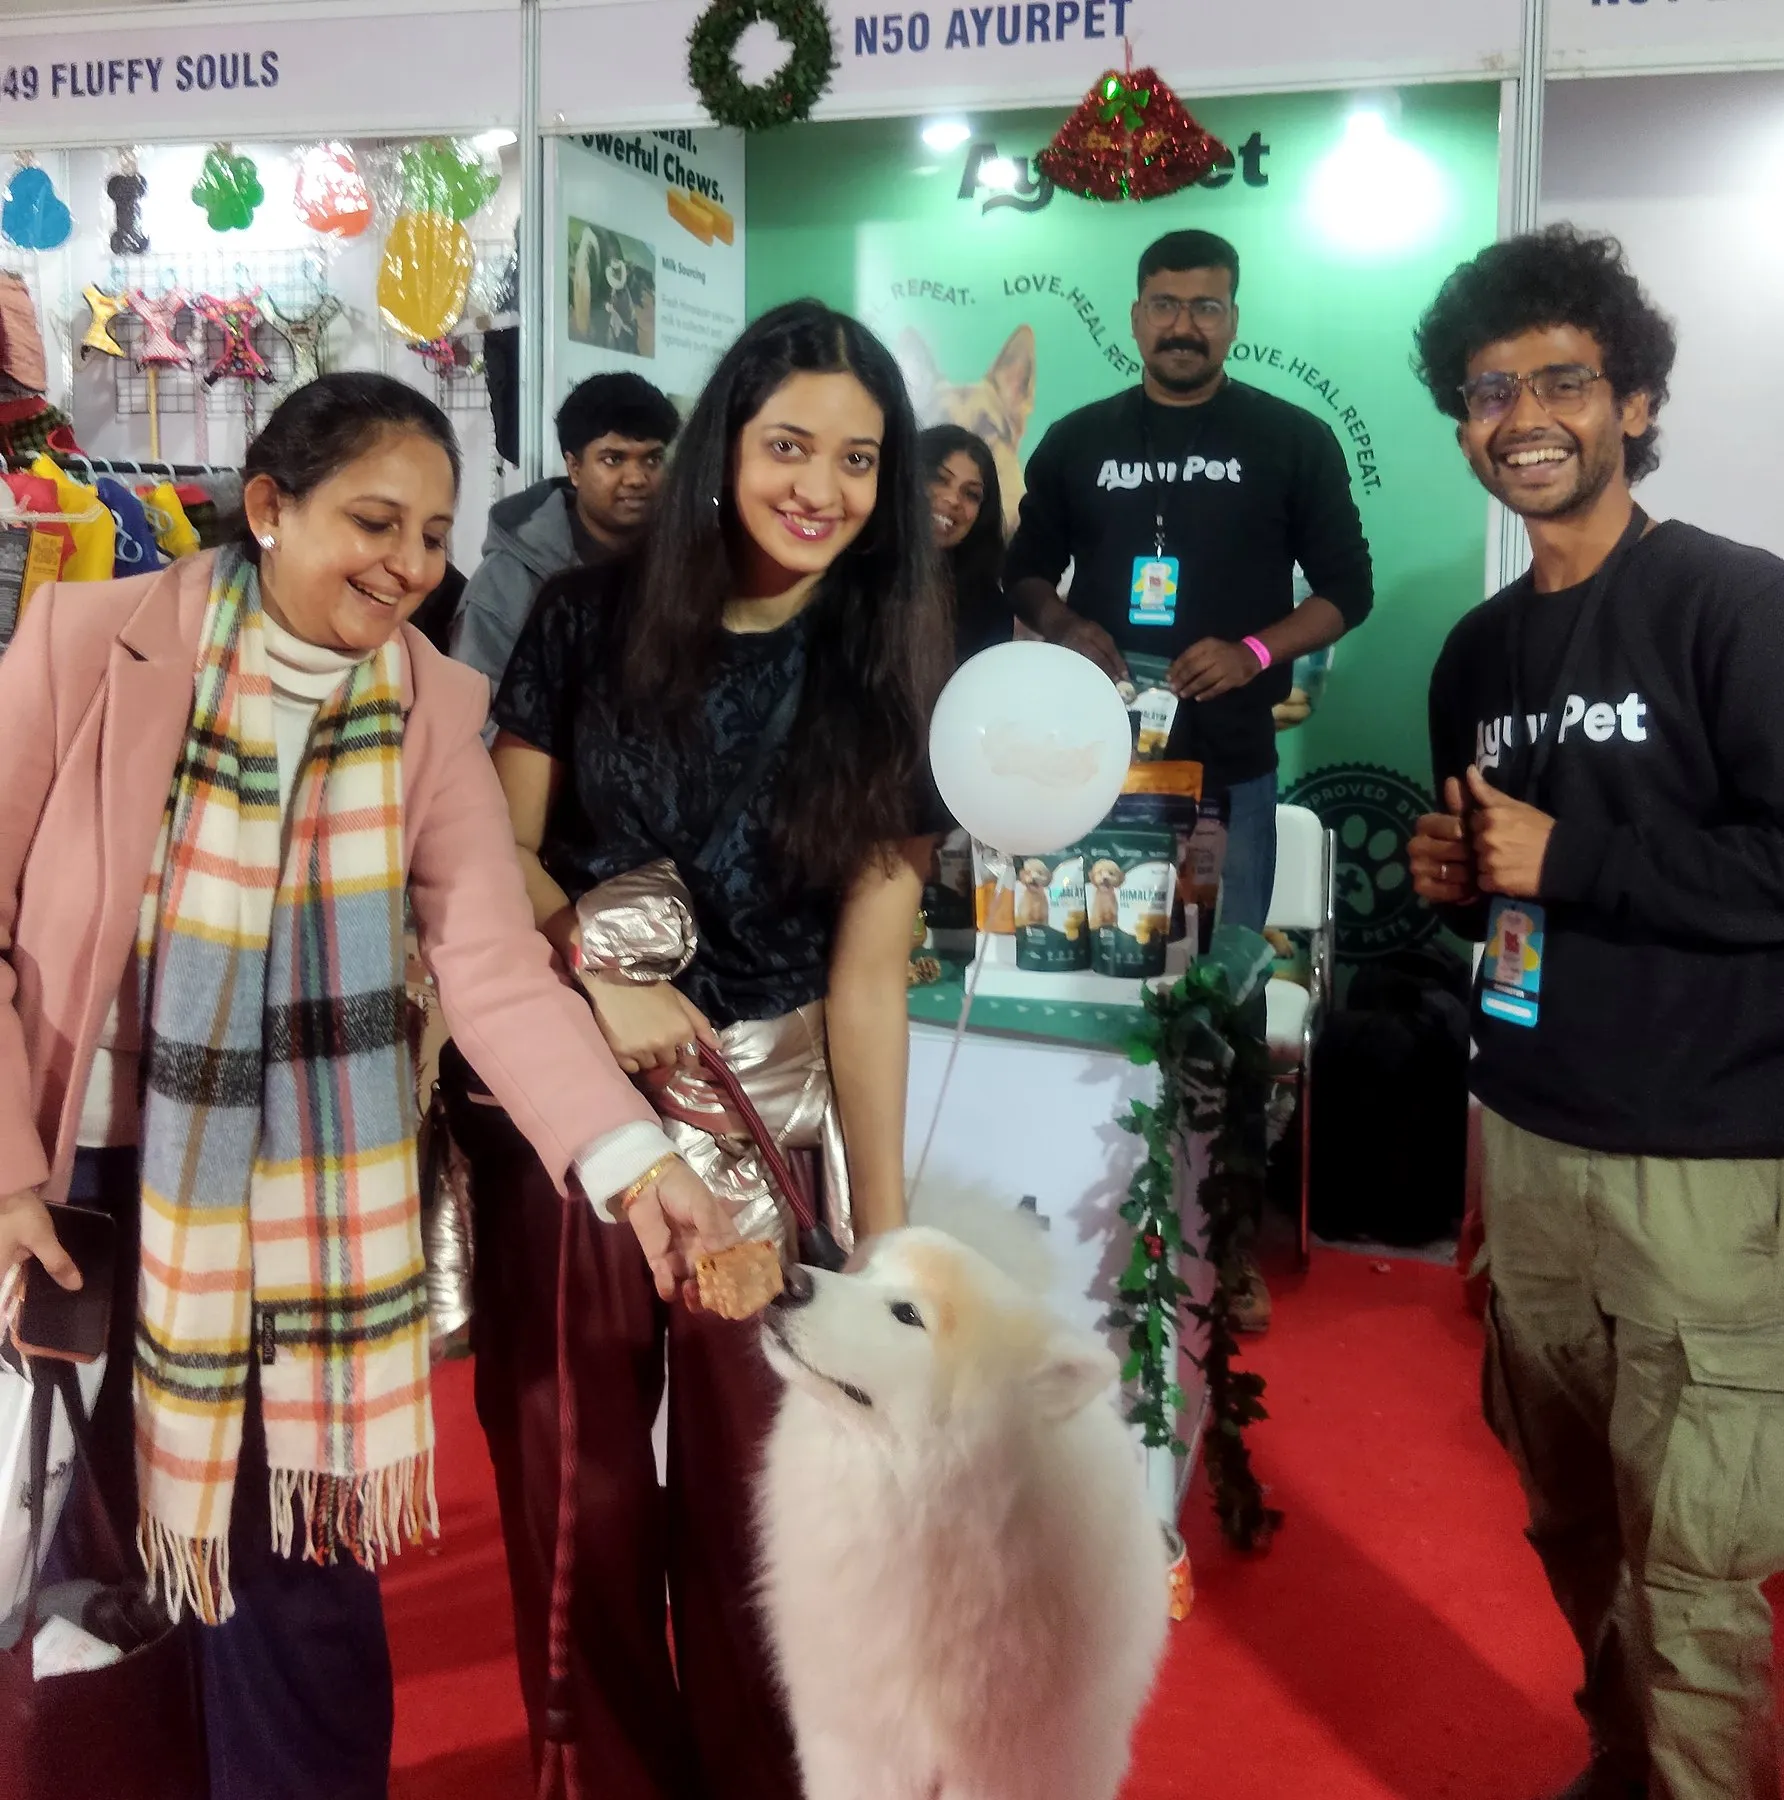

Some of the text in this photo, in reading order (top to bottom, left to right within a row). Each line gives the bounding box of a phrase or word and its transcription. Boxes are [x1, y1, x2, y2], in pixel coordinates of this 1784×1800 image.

[854, 0, 1132, 56] N50 AYURPET
[51, 57, 163, 98] FLUFFY
[176, 50, 279, 92] SOULS
[653, 129, 697, 155] ural.
[568, 131, 724, 203] owerful Chews.
[661, 256, 707, 286] Milk Sourcing
[1226, 343, 1285, 370] OVE.
